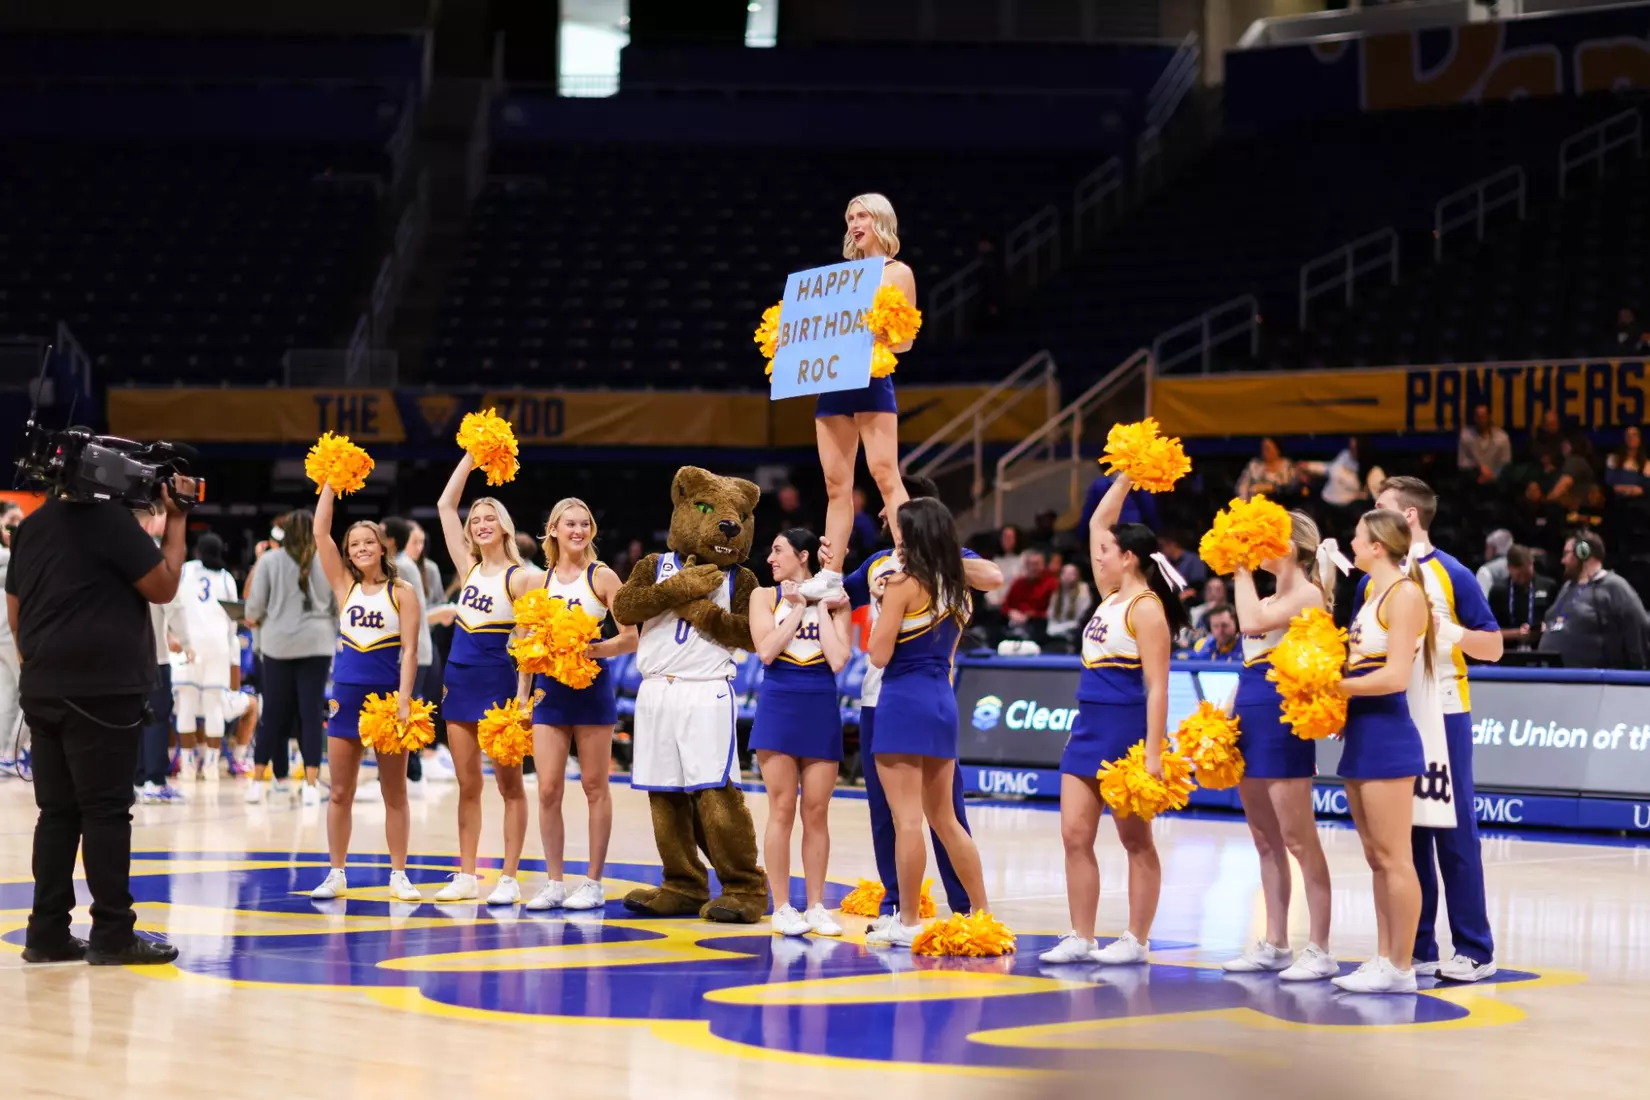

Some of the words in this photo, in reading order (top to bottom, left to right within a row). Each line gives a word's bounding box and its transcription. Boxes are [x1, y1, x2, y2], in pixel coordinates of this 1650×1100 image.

[796, 267, 864, 302] HAPPY
[797, 354, 839, 385] ROC
[313, 394, 378, 433] THE
[198, 576, 211, 602] 3
[461, 584, 494, 614] Pitt
[347, 605, 385, 629] Pitt
[1085, 616, 1109, 644] Pitt
[1471, 718, 1505, 746] dit
[1508, 718, 1588, 749] Union
[1592, 722, 1627, 750] of
[978, 769, 1039, 796] UPMC
[1413, 761, 1451, 804] itt
[1311, 788, 1348, 814] MC
[1473, 796, 1523, 823] PMC
